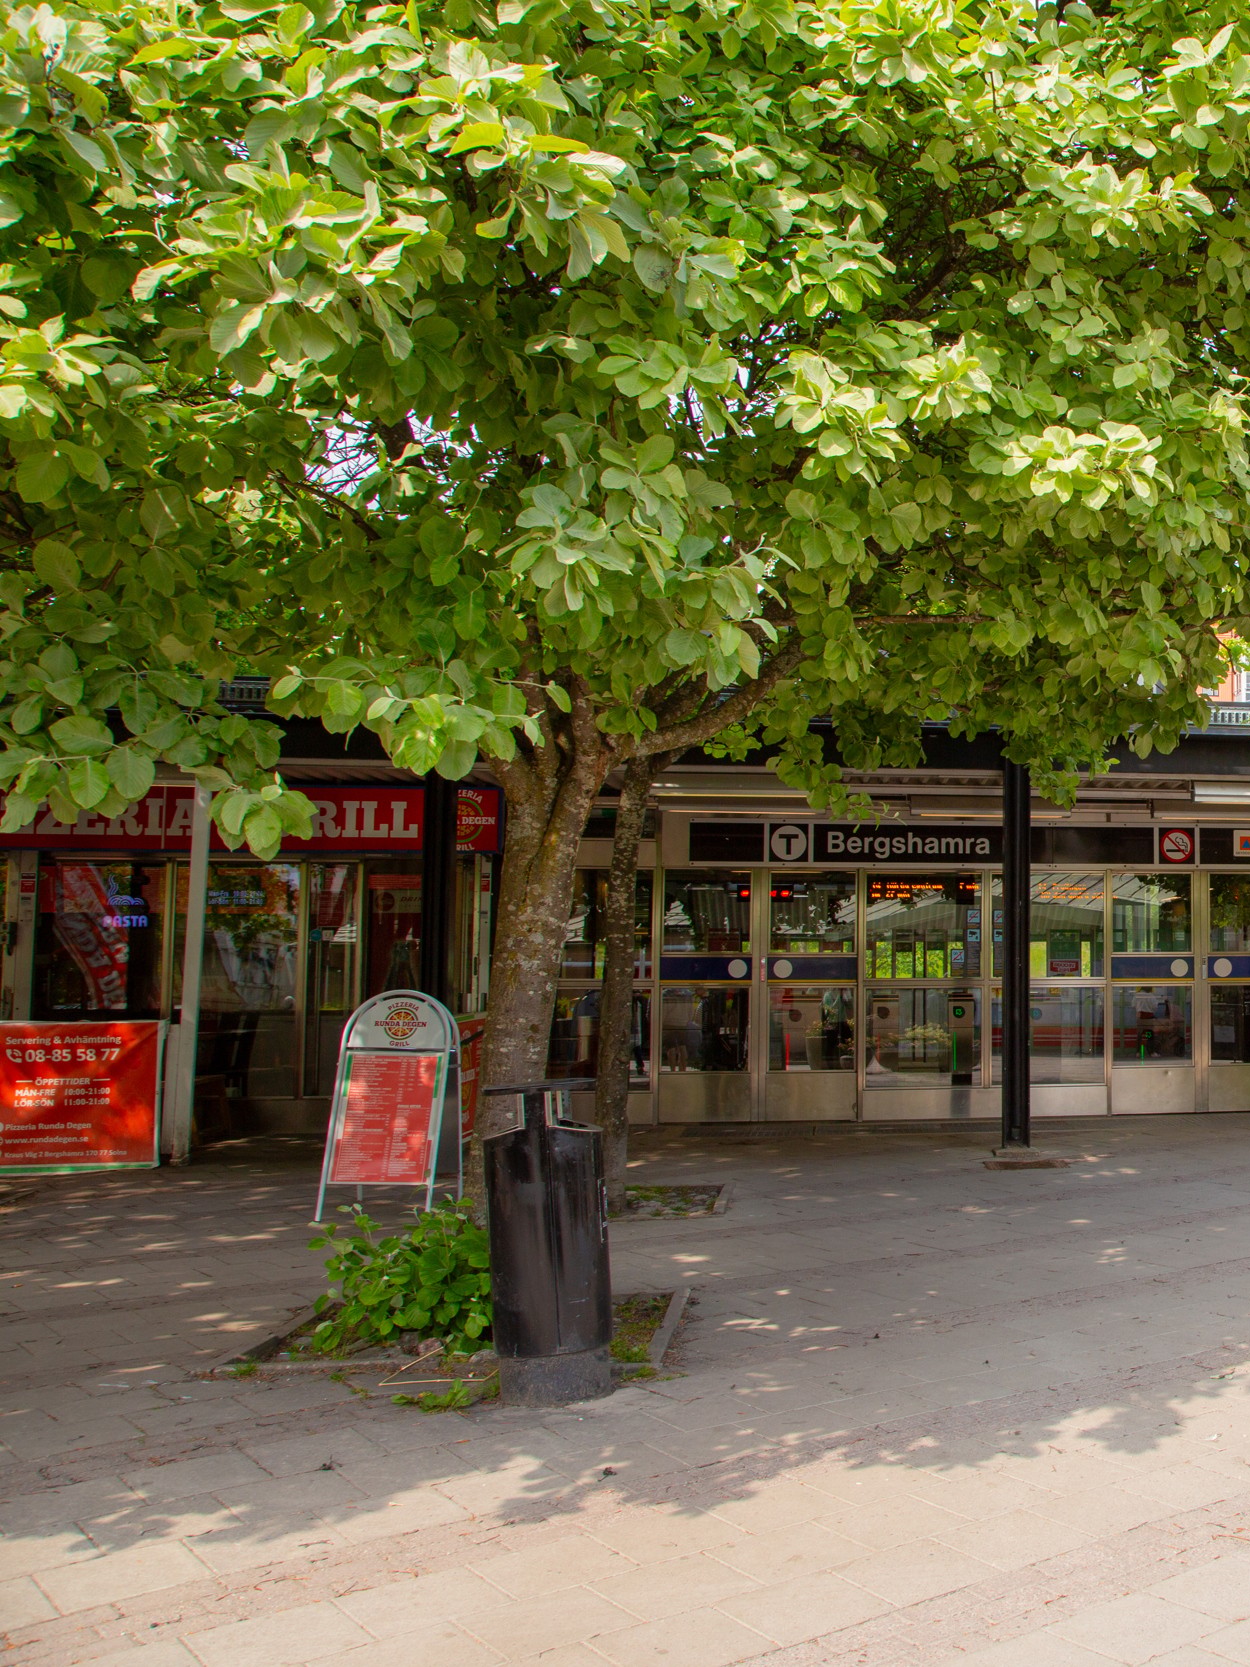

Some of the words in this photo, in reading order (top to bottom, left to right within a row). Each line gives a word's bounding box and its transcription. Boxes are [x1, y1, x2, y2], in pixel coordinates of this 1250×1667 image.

[282, 800, 418, 839] RILL
[462, 816, 496, 825] DEGEN
[827, 831, 990, 859] Bergshamra
[102, 915, 148, 928] PASTA
[387, 1001, 419, 1011] PIZZERIA
[6, 1036, 51, 1046] Servering
[53, 1036, 61, 1044] &
[64, 1034, 122, 1045] Avhämtning
[25, 1048, 72, 1062] 08-85
[76, 1048, 96, 1061] 58
[101, 1047, 120, 1061] 77
[35, 1077, 91, 1086] ÖPPETTIDER
[15, 1087, 56, 1097] MÅN-FRE
[64, 1087, 111, 1095] 10:00-21:00
[14, 1098, 55, 1107] LÖR-SÖN
[64, 1098, 110, 1106] 11:00-21:00
[5, 1122, 36, 1131] Pizzeria
[38, 1121, 64, 1130] Runda
[66, 1121, 92, 1131] Degen
[5, 1135, 89, 1145] www.rundadegen.se
